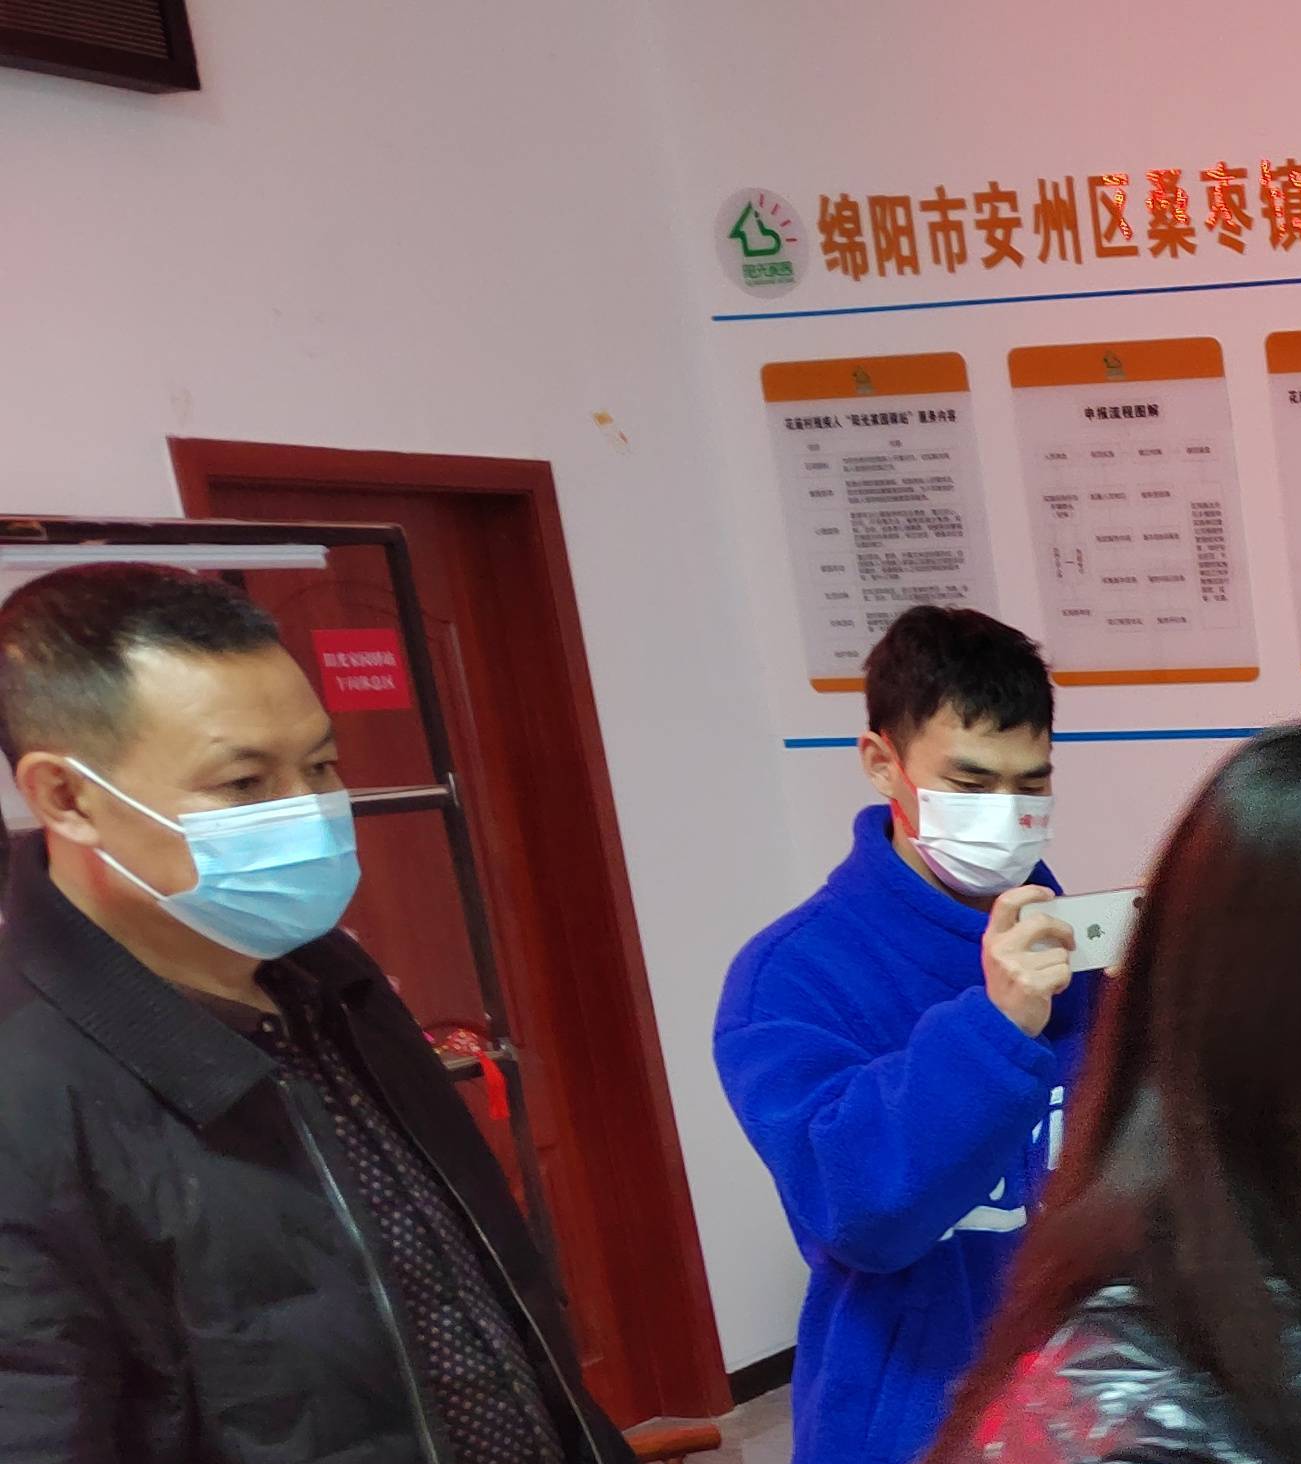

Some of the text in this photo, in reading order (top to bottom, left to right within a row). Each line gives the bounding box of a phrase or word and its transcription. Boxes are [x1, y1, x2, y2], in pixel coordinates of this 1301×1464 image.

[1084, 404, 1159, 422] 申报流程图解
